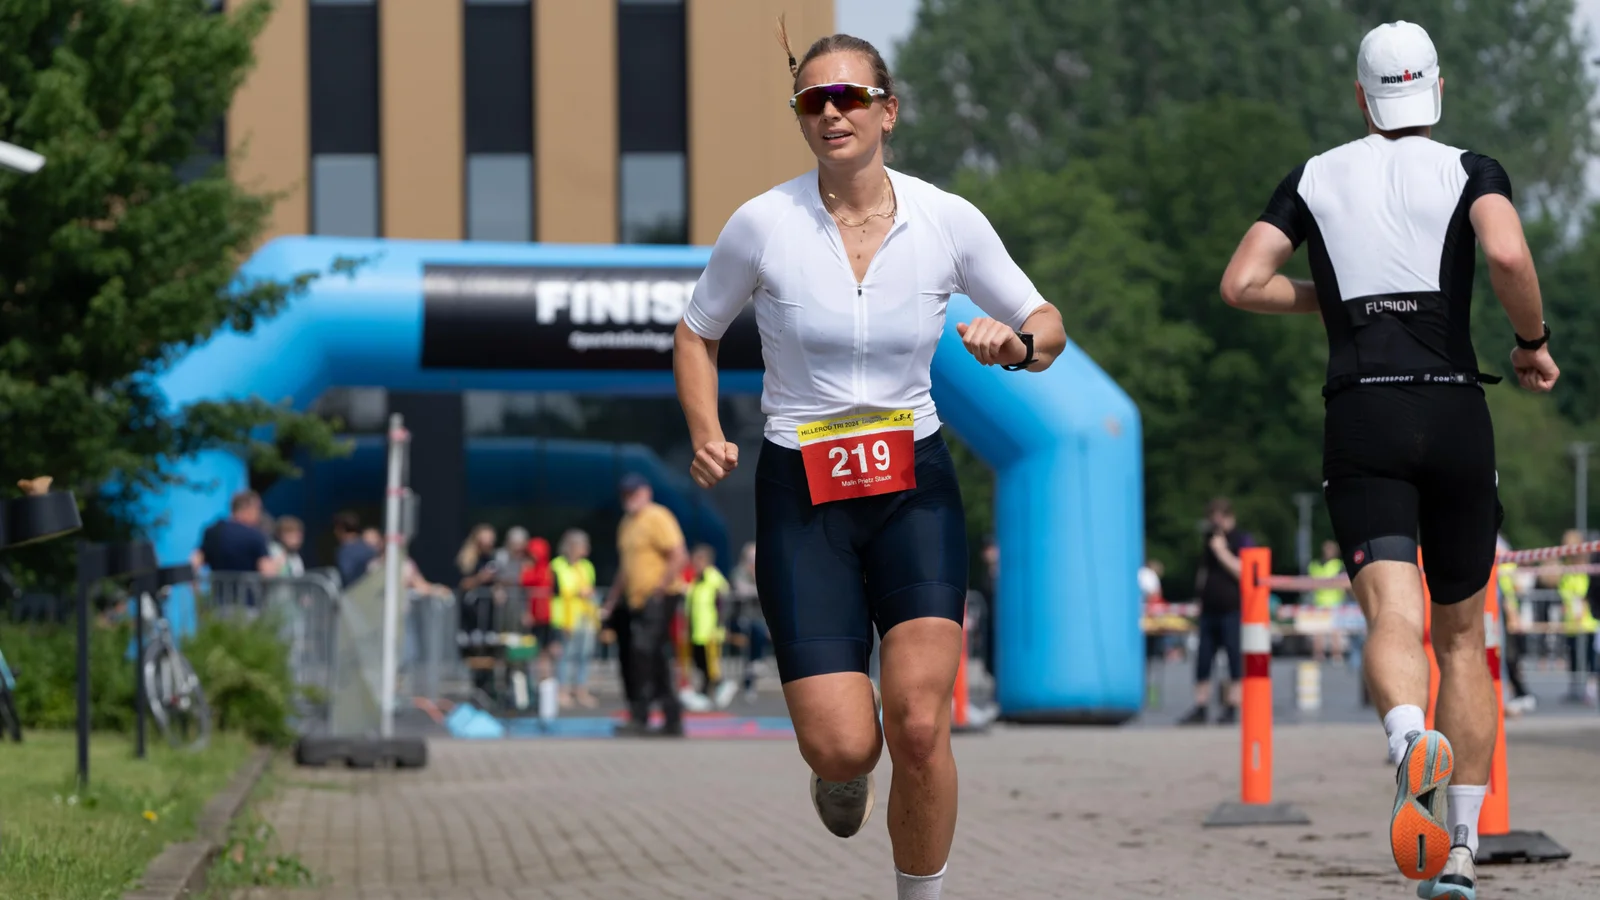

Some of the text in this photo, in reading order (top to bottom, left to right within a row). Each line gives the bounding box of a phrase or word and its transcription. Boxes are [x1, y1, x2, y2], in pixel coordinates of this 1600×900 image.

[1381, 69, 1423, 84] IRONMAN
[1365, 300, 1418, 315] FUSION
[829, 440, 890, 478] 219
